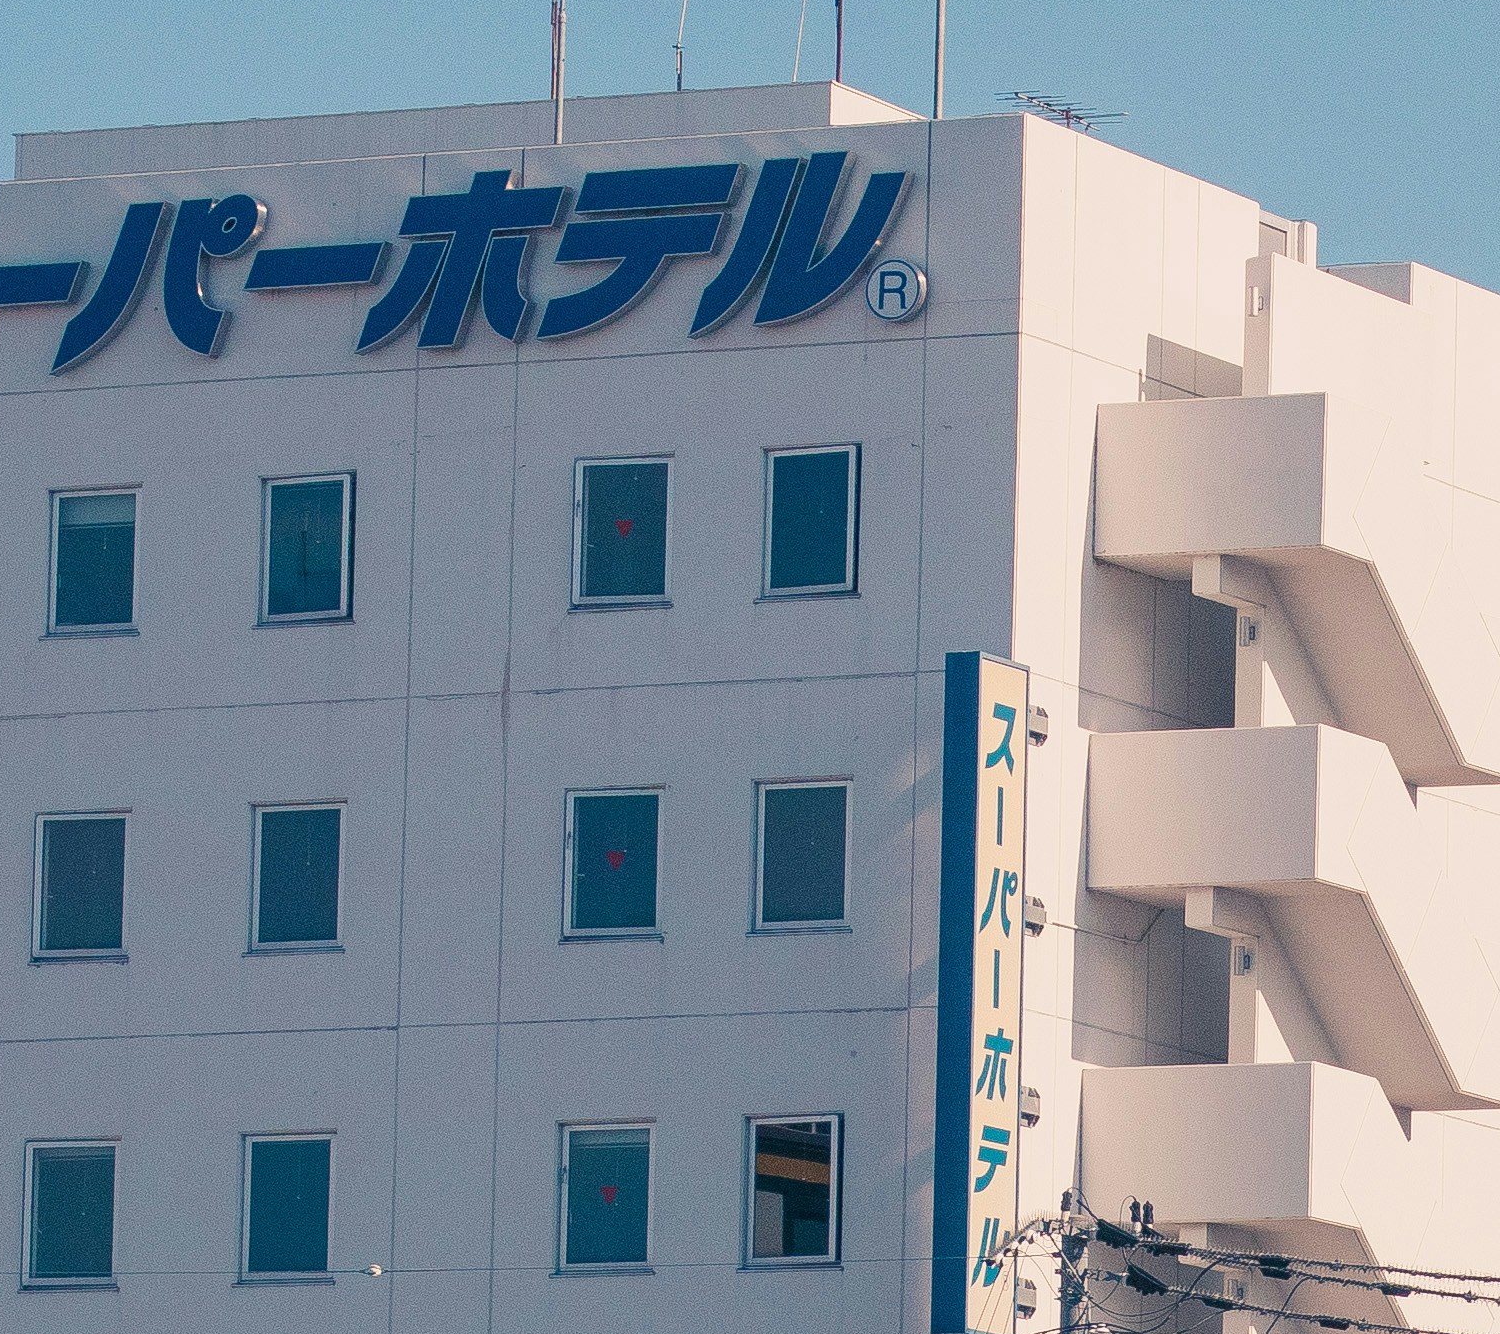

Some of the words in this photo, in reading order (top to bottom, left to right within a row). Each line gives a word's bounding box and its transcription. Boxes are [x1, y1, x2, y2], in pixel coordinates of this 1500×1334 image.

[973, 703, 1018, 1289] スーパーホテル
